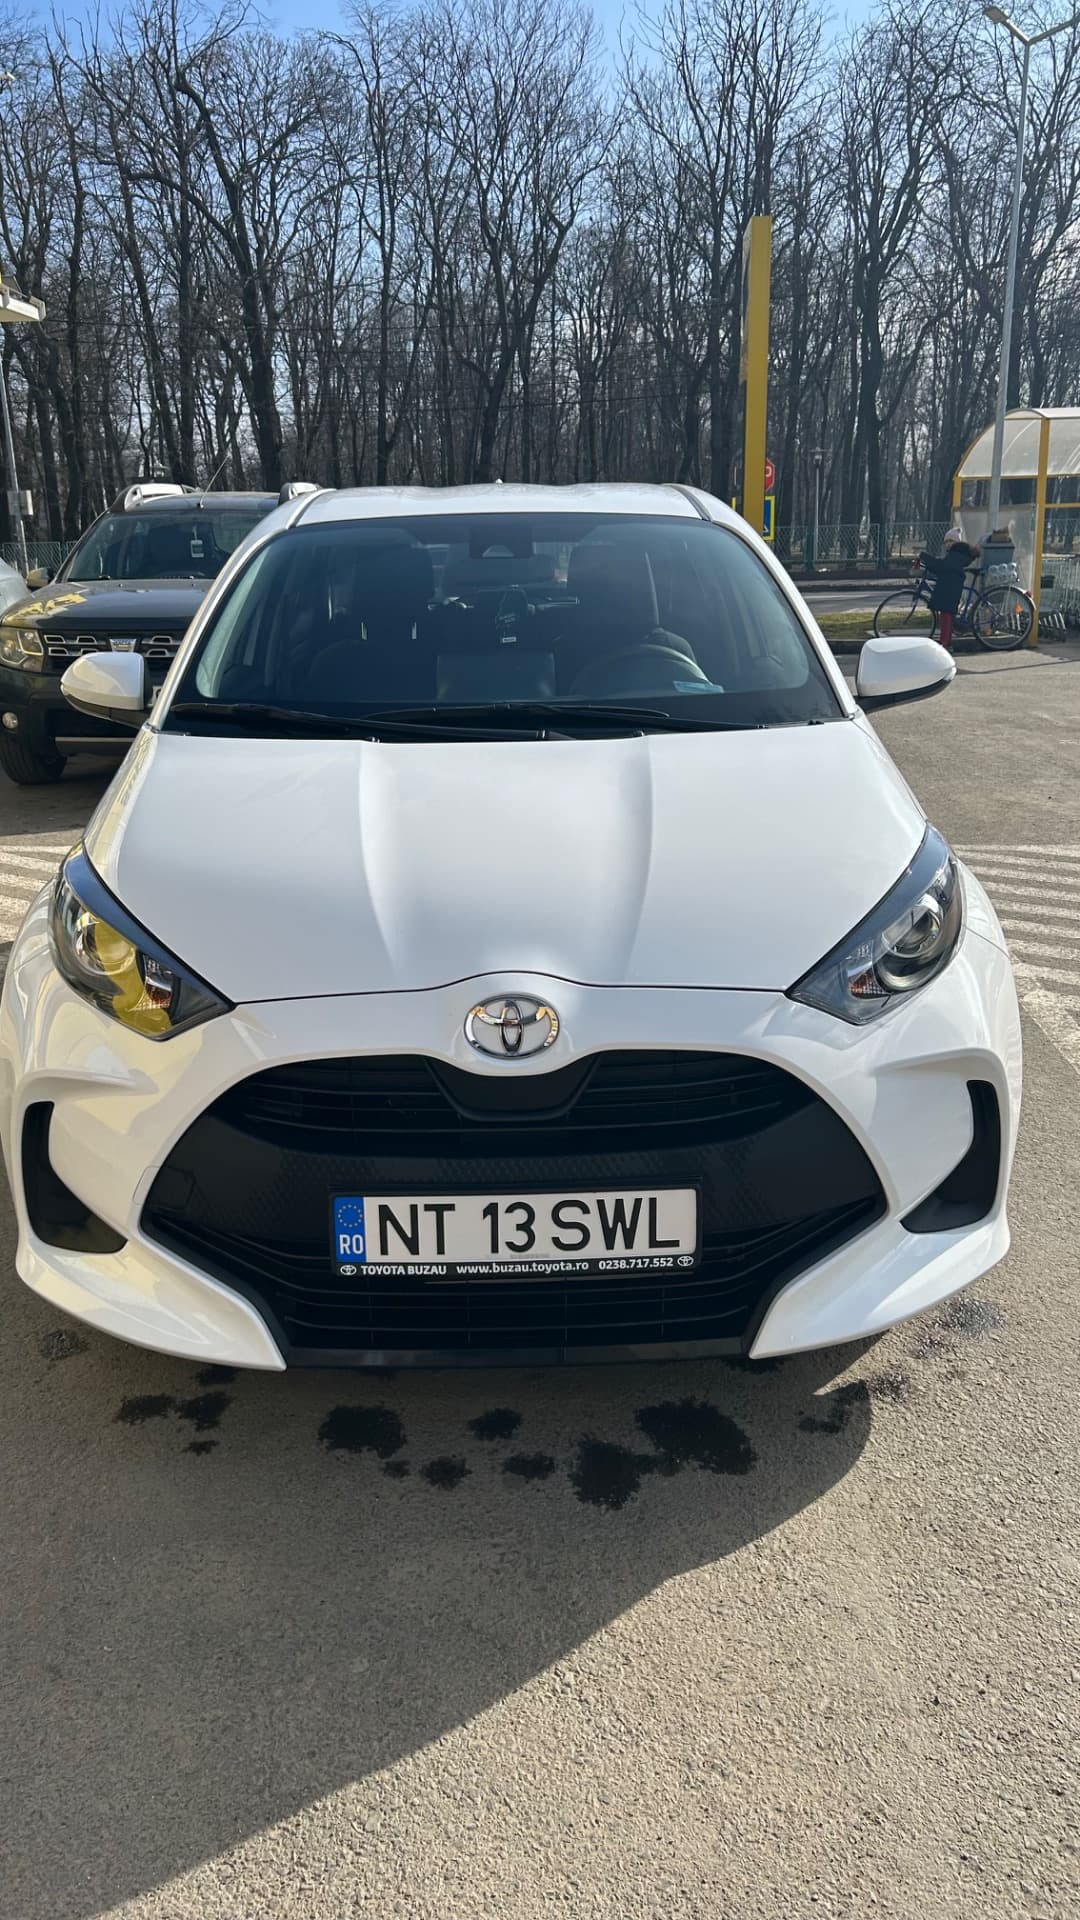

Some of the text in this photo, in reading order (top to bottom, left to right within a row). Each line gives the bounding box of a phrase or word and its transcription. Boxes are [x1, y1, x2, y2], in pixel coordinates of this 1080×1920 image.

[378, 1197, 680, 1256] NT 13 SWL
[339, 1234, 364, 1255] RO
[361, 1257, 674, 1275] TOYOTA BUZAU www.buzau.toyota.ro 0238.717.552
